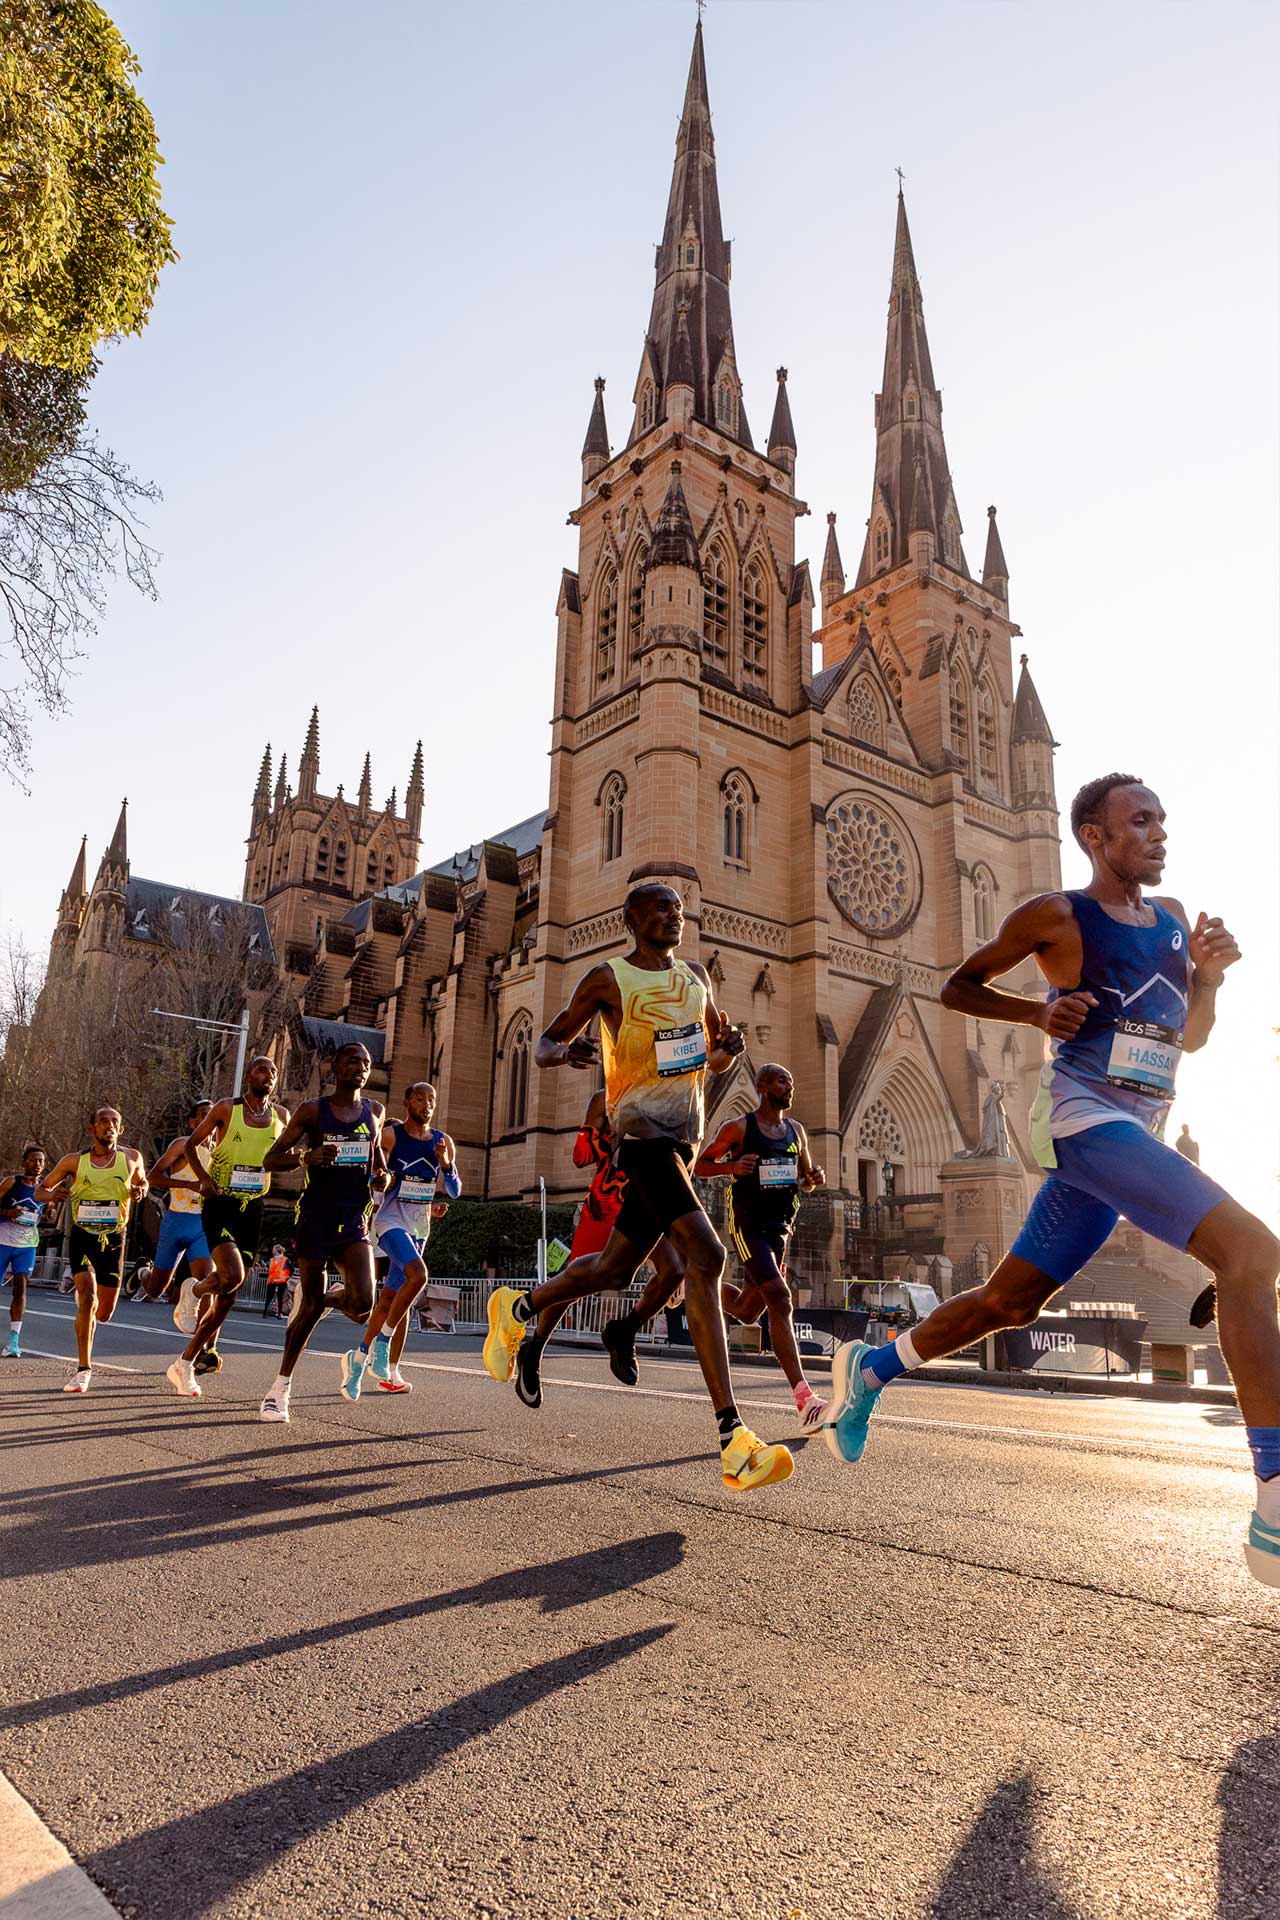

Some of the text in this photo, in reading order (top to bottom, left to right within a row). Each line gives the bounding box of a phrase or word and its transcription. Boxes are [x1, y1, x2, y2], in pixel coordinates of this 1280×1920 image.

[1124, 1020, 1144, 1034] tcs
[673, 1042, 698, 1056] KIBET
[794, 1322, 813, 1339] TER
[1030, 1331, 1076, 1353] WATER
